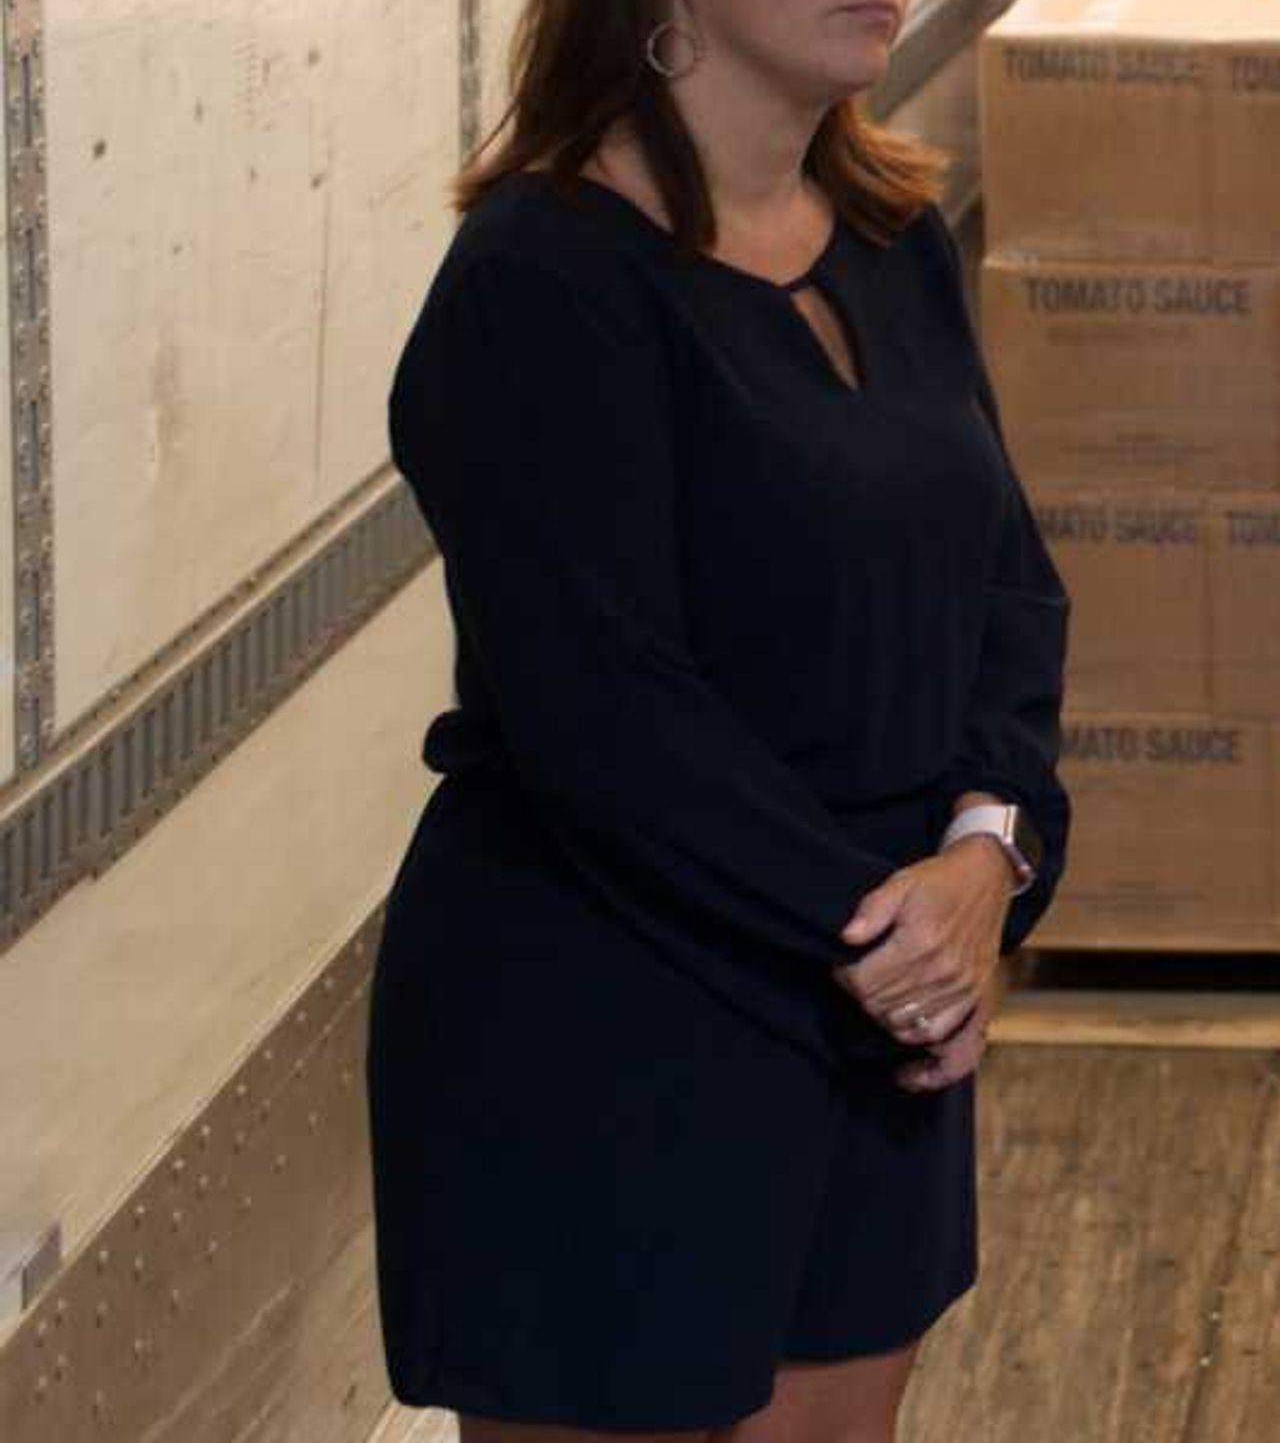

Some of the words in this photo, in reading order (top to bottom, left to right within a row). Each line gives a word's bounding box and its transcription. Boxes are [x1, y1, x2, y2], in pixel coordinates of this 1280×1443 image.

[1003, 46, 1104, 82] TOMATO
[1024, 278, 1148, 315] TOMATO
[1152, 279, 1251, 317] SAUCE
[1113, 508, 1199, 546] SAUCE
[1146, 727, 1242, 764] SAUCE
